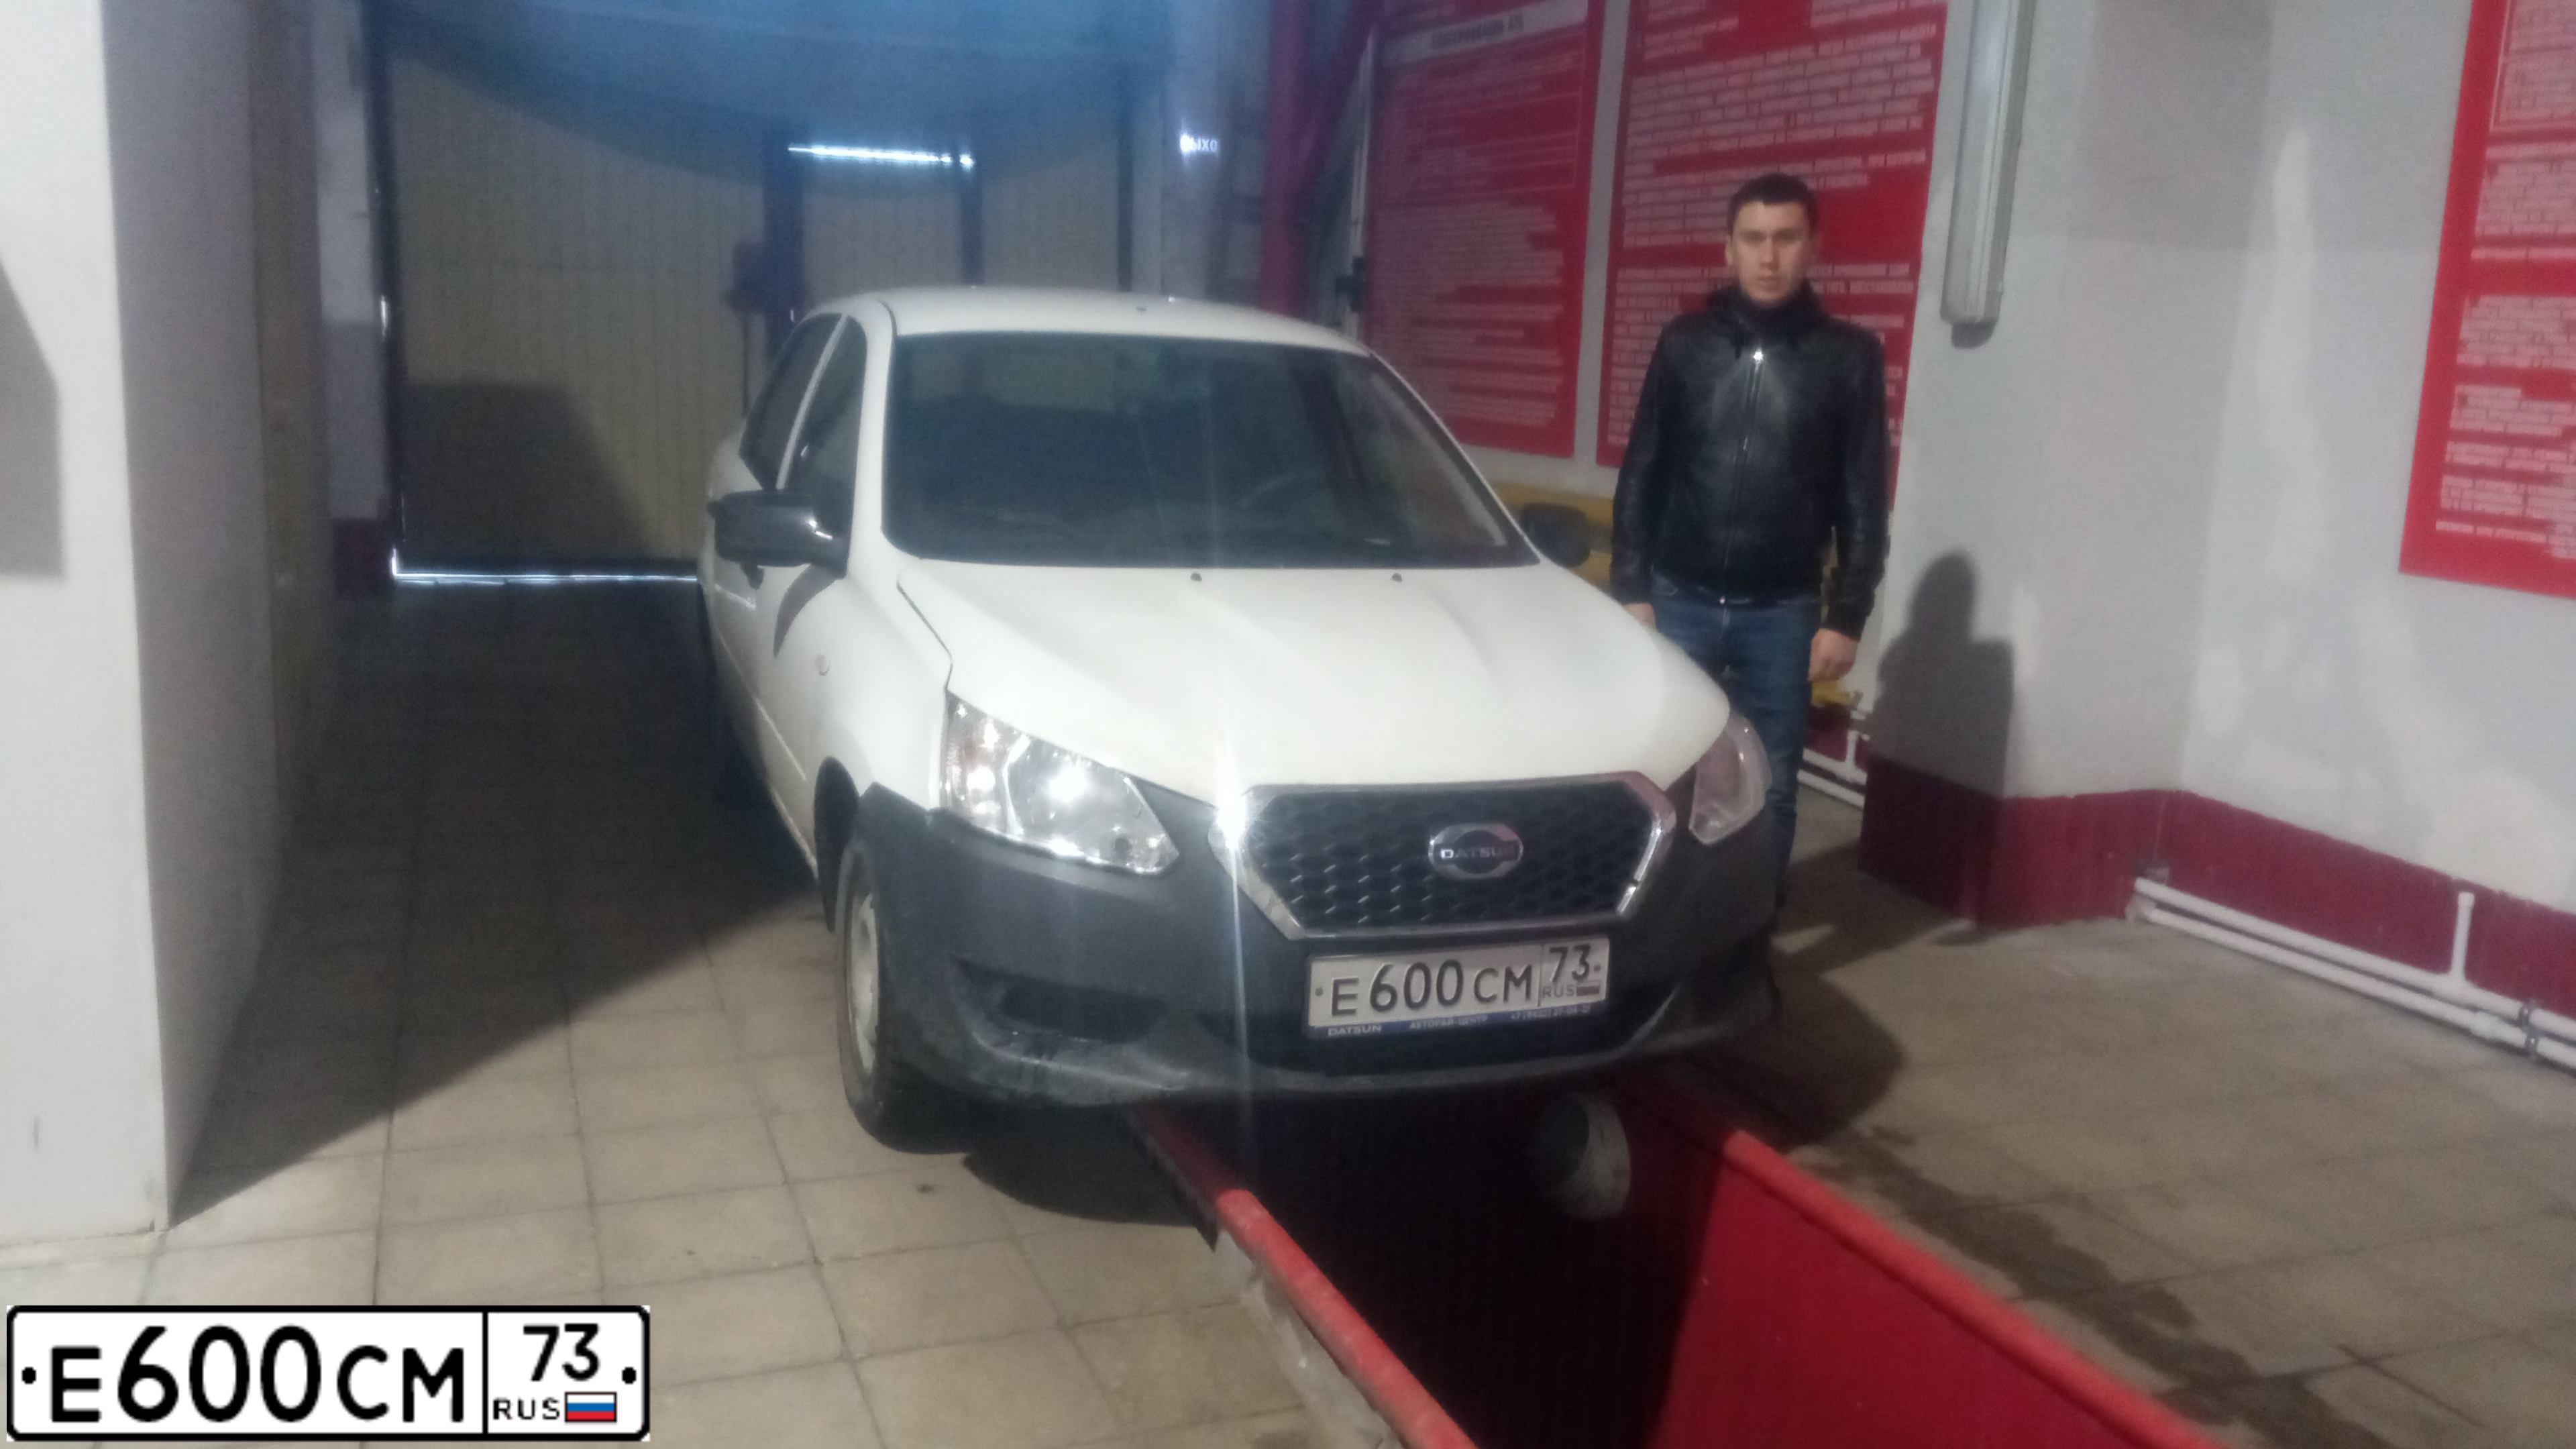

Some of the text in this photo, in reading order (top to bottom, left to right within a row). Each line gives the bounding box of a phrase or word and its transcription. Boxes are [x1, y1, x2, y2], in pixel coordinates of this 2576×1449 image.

[1549, 944, 1591, 982] 73
[1543, 985, 1574, 998] RUS
[1328, 1024, 1382, 1036] DATSUN
